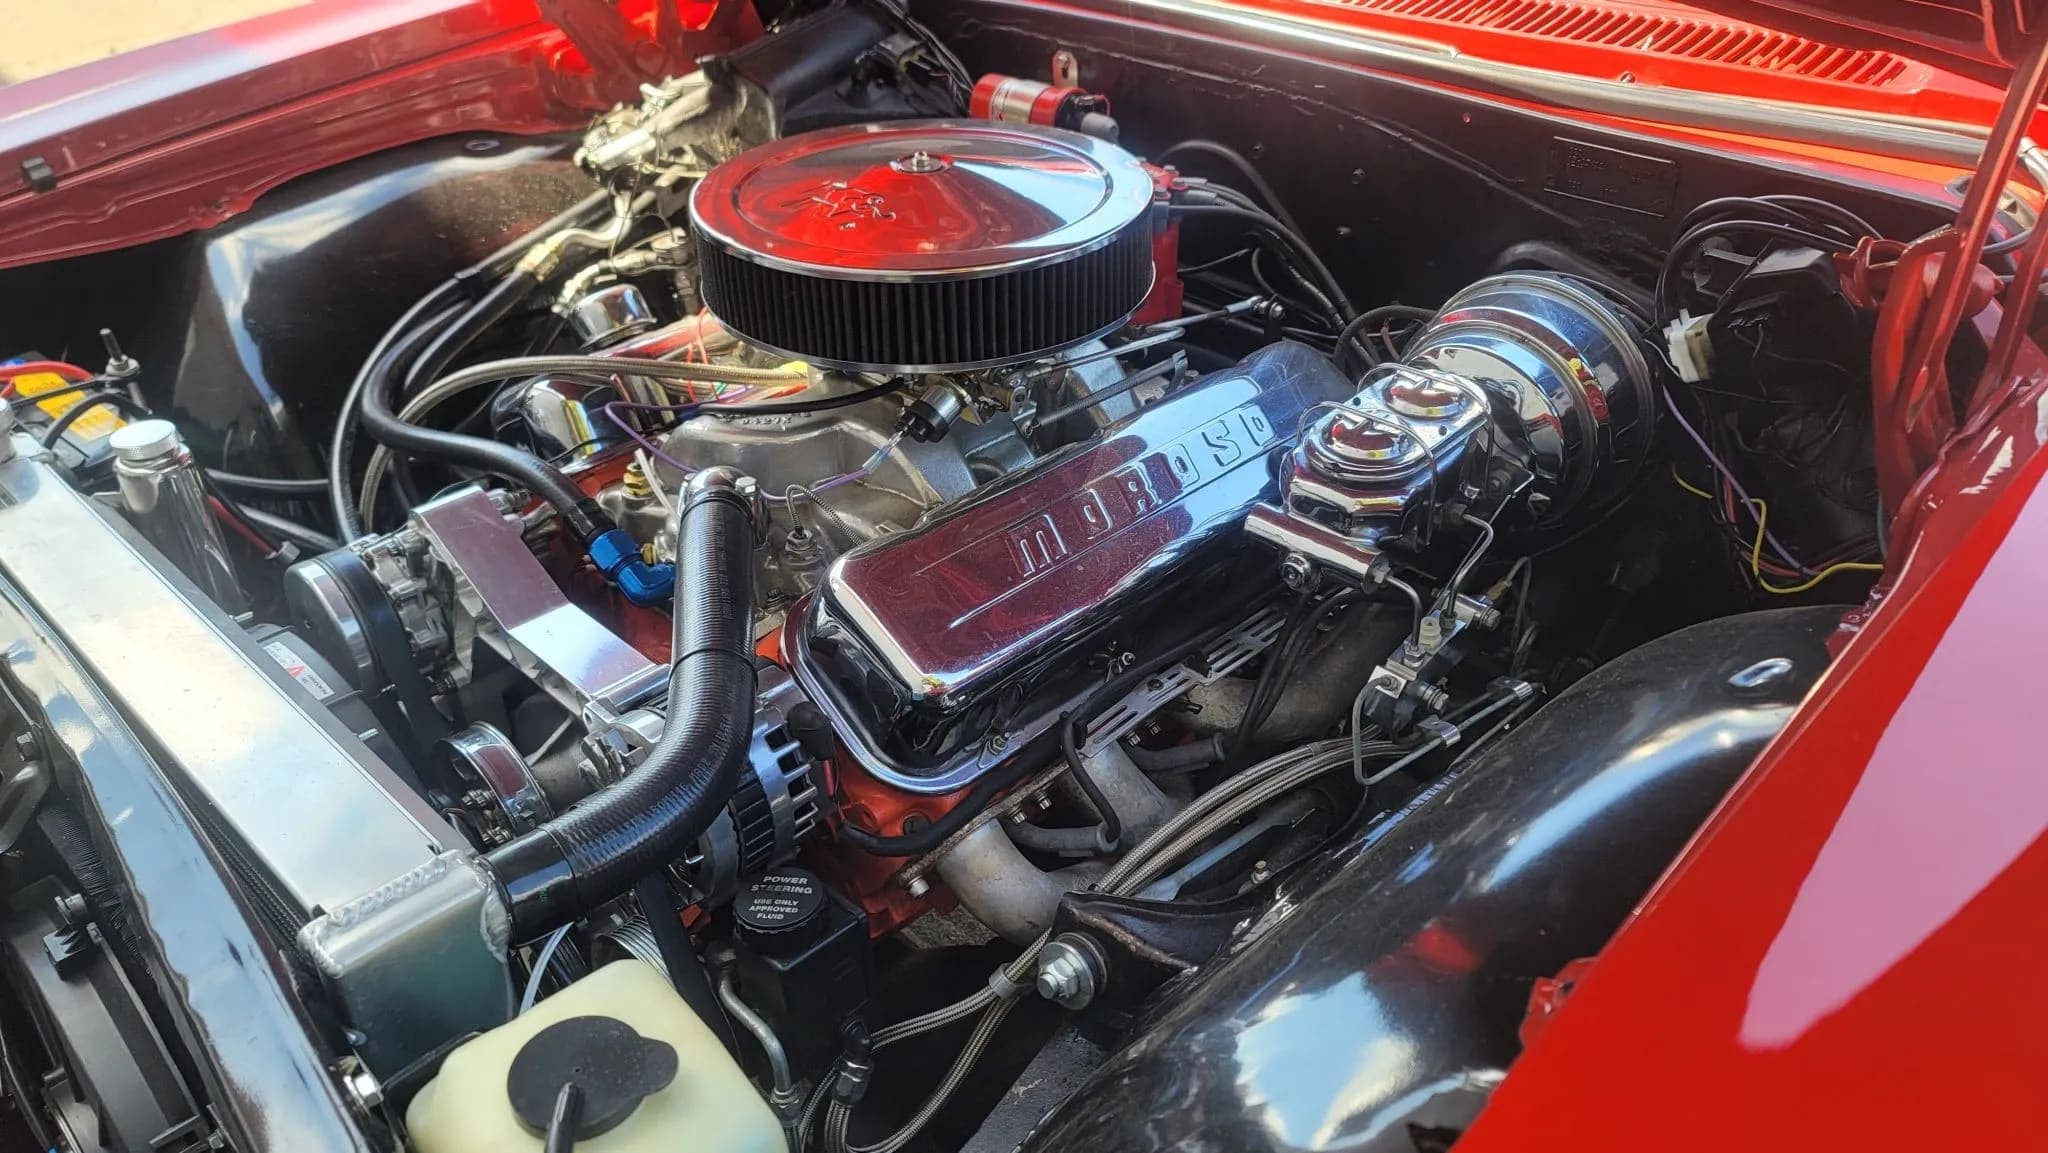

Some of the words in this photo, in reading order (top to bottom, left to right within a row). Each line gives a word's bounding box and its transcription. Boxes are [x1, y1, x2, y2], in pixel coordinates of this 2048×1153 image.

[1002, 402, 1277, 578] MOROSO
[763, 876, 808, 885] POWER
[751, 884, 813, 894] STEERING
[749, 905, 799, 913] APPROVED
